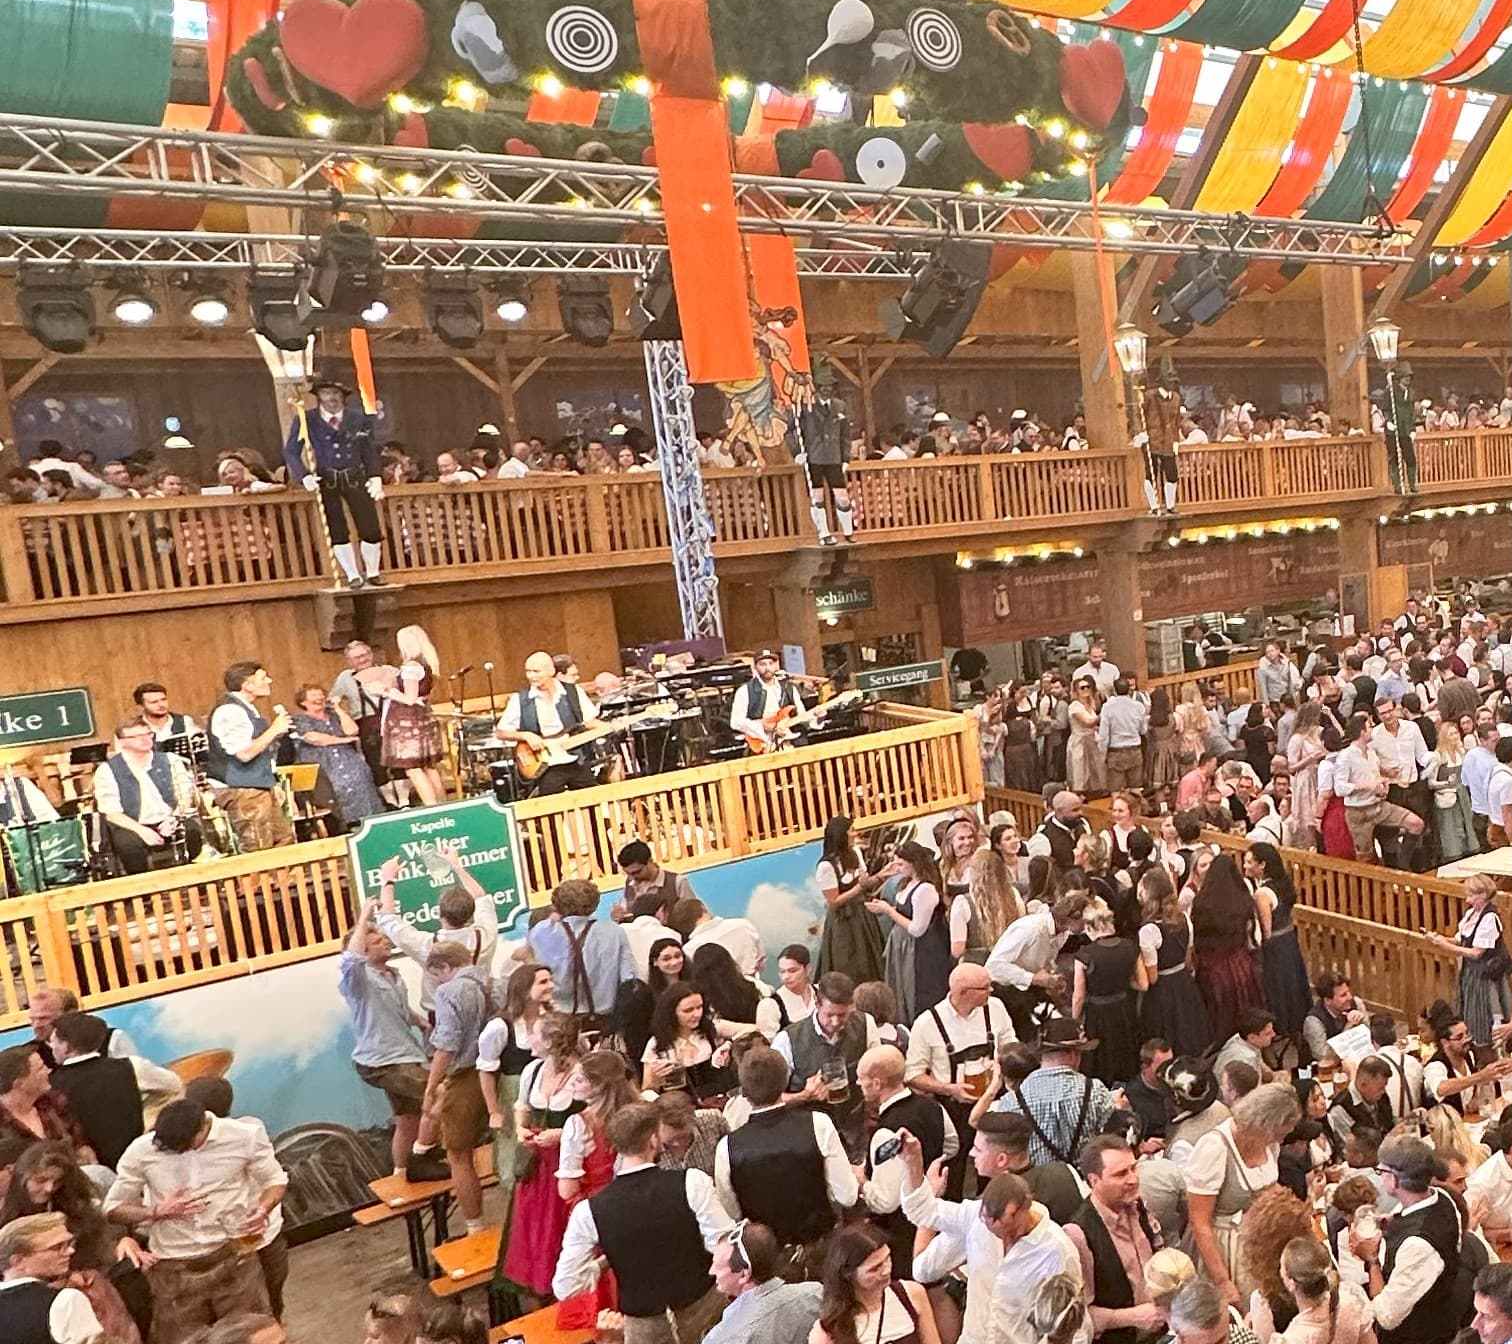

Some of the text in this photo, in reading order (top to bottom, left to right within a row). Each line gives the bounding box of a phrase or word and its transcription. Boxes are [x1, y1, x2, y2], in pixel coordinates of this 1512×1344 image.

[868, 669, 930, 688] Servicegang
[56, 705, 71, 726] 1
[410, 816, 456, 835] Kapelle
